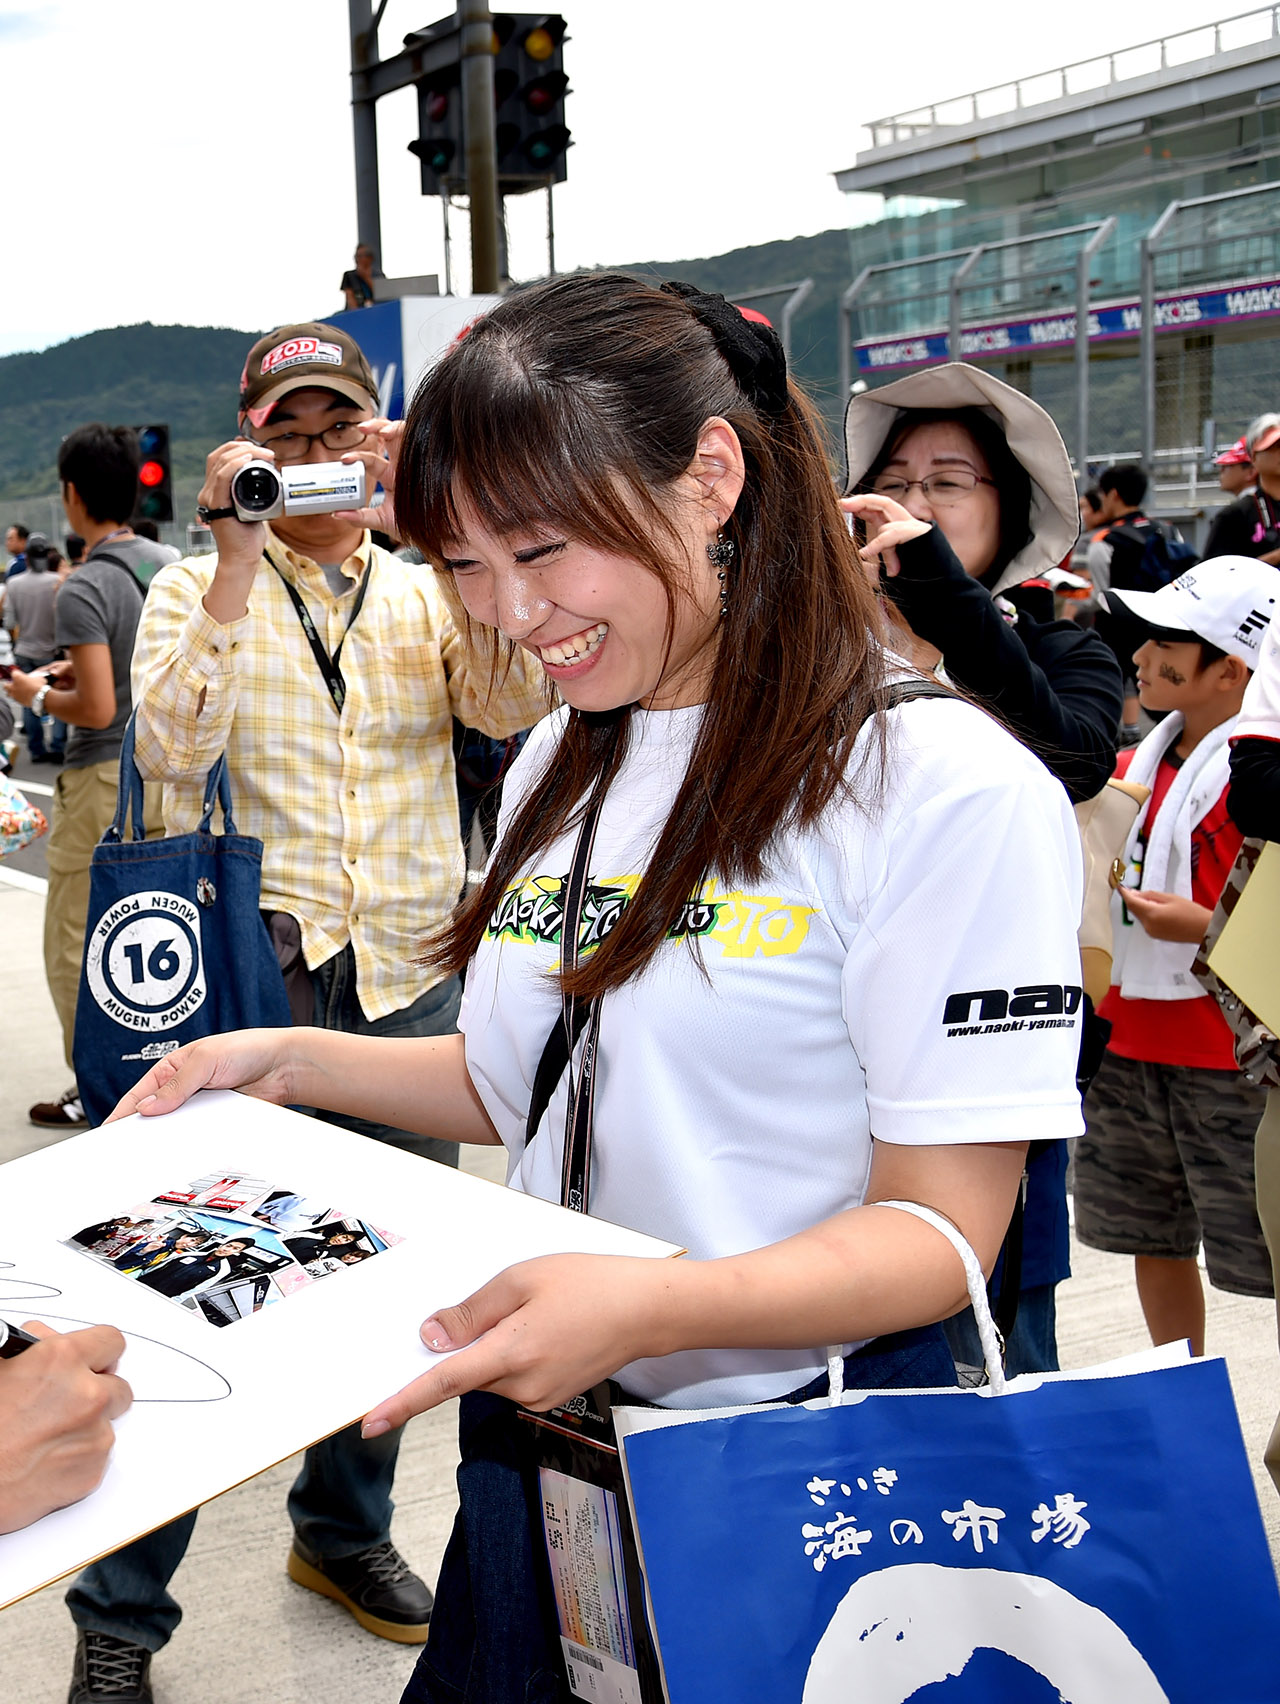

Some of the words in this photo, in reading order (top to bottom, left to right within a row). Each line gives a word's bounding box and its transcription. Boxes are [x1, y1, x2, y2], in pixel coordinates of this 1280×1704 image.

[263, 340, 315, 370] IZOD
[98, 899, 140, 937] POWER
[151, 896, 197, 923] MUGEN
[123, 938, 180, 984] 16
[103, 998, 151, 1028] MUGEN
[160, 987, 204, 1026] POWER
[806, 1466, 899, 1507] さいき
[801, 1492, 1092, 1573] 海の市場
